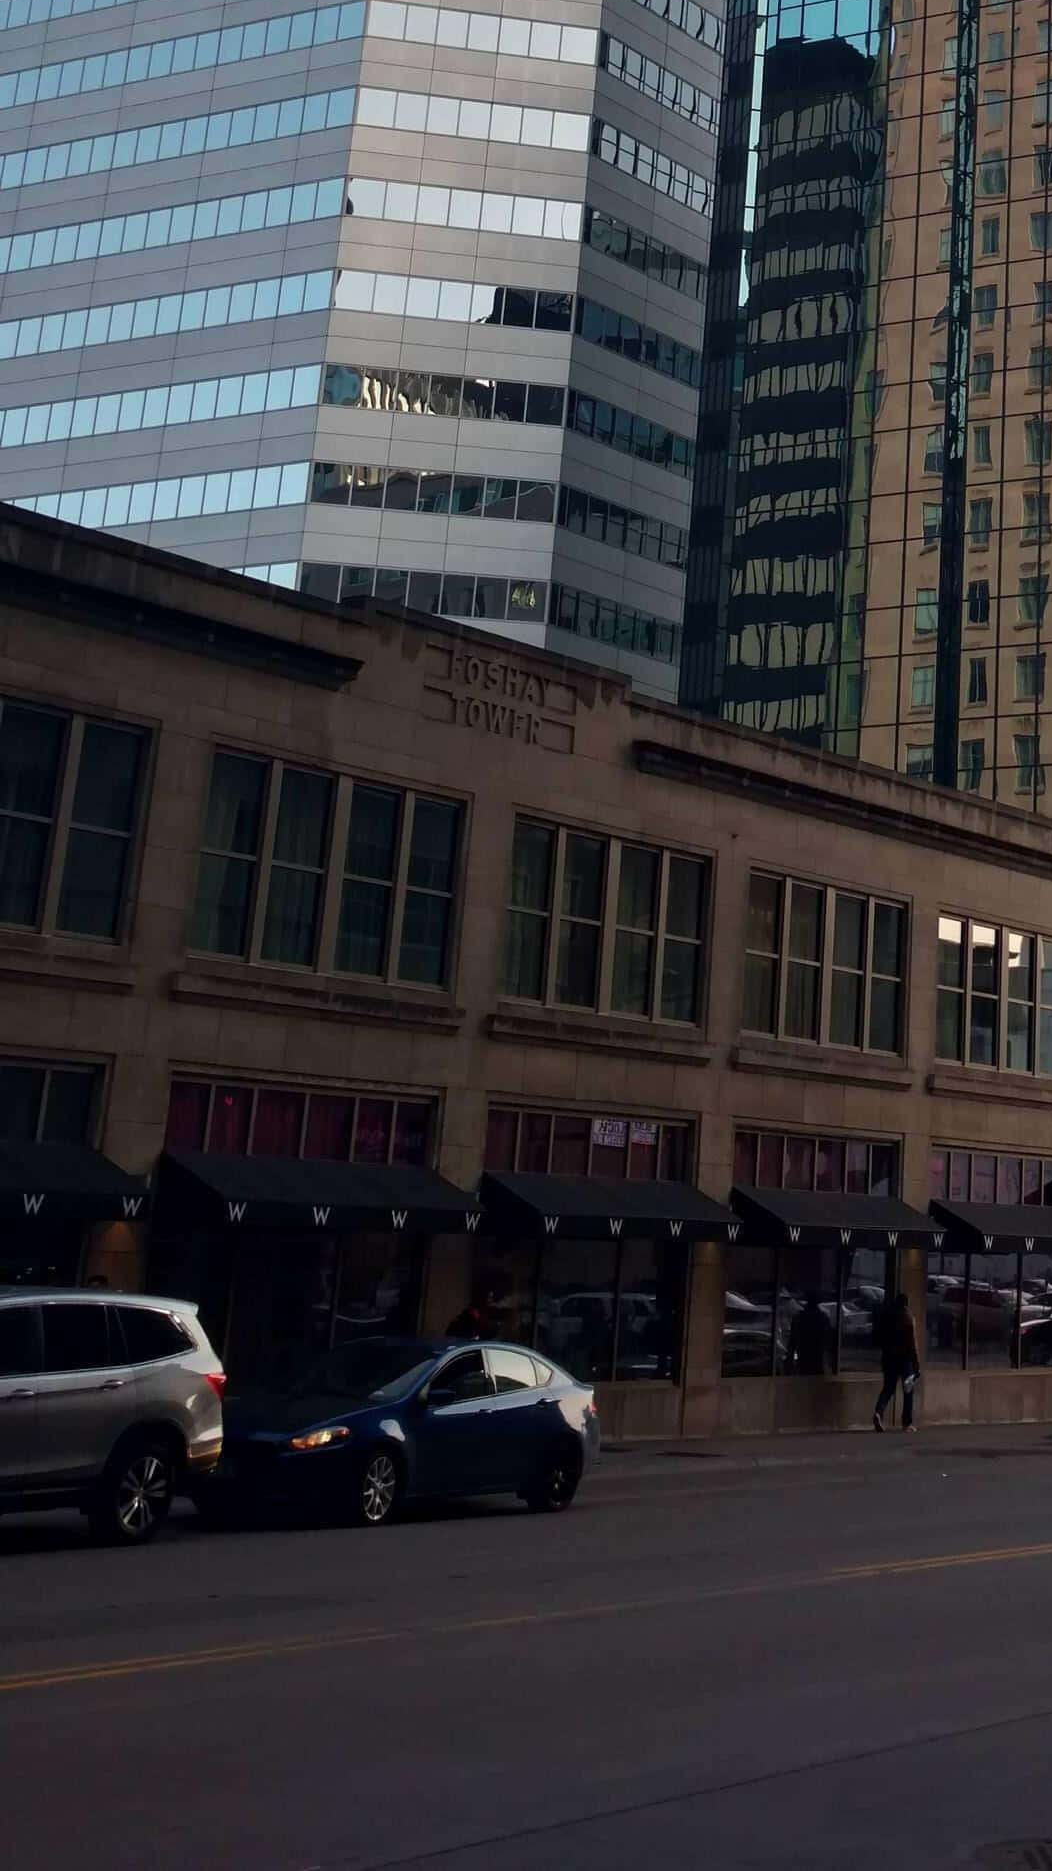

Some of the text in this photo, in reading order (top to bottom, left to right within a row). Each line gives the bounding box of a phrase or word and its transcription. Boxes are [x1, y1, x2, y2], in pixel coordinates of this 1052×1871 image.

[452, 654, 553, 708] FOSHAY
[452, 696, 543, 745] TOWER
[23, 1193, 143, 1217] W W
[228, 1201, 481, 1231] W W W W
[544, 1216, 741, 1241] W W W W
[789, 1225, 945, 1248] W W W W
[983, 1235, 994, 1250] W
[1025, 1237, 1036, 1251] W
